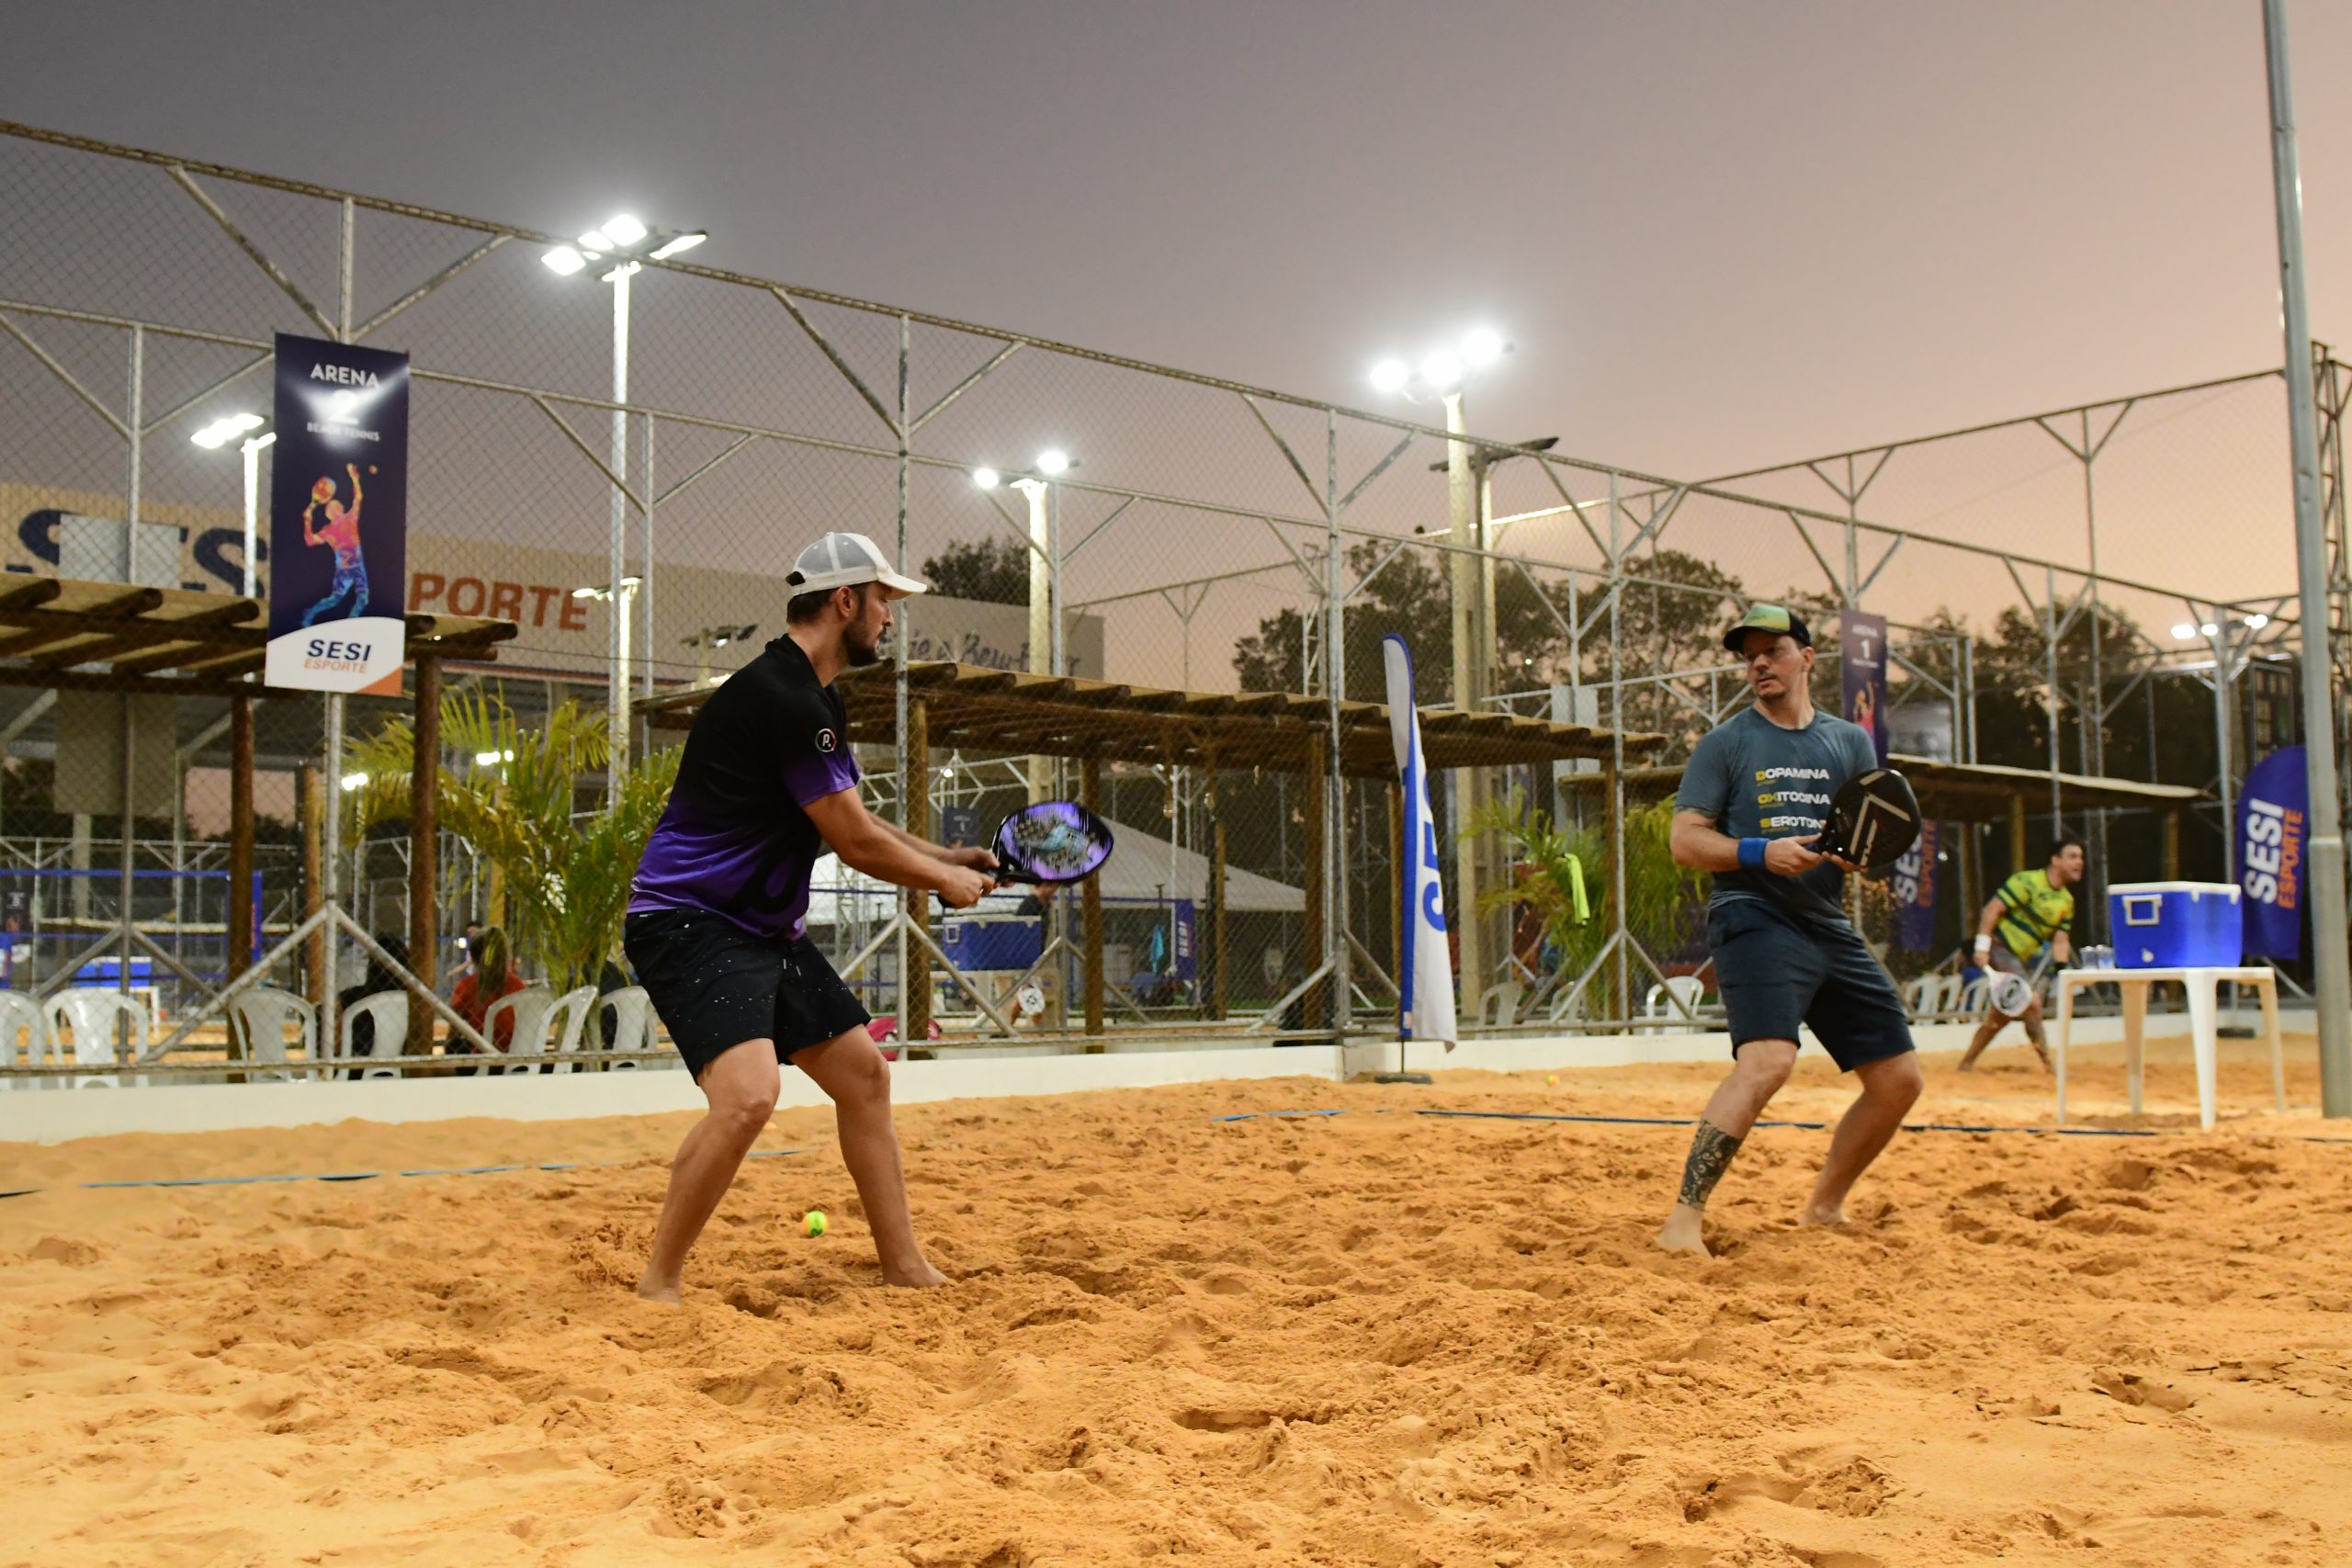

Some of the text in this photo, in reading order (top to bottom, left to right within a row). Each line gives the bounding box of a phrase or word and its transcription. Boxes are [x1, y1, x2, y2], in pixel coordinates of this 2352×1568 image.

[311, 363, 380, 388] ARENA
[328, 388, 358, 425] 2
[408, 572, 588, 632] PORTE
[306, 639, 371, 661] SESI
[1860, 639, 1871, 660] 1
[304, 658, 368, 673] ESPORTE
[1755, 767, 1830, 781] DOPAMINA
[1758, 791, 1831, 805] OXITOCINA
[2245, 797, 2285, 905] SESI
[2278, 807, 2303, 909] ESPORTE
